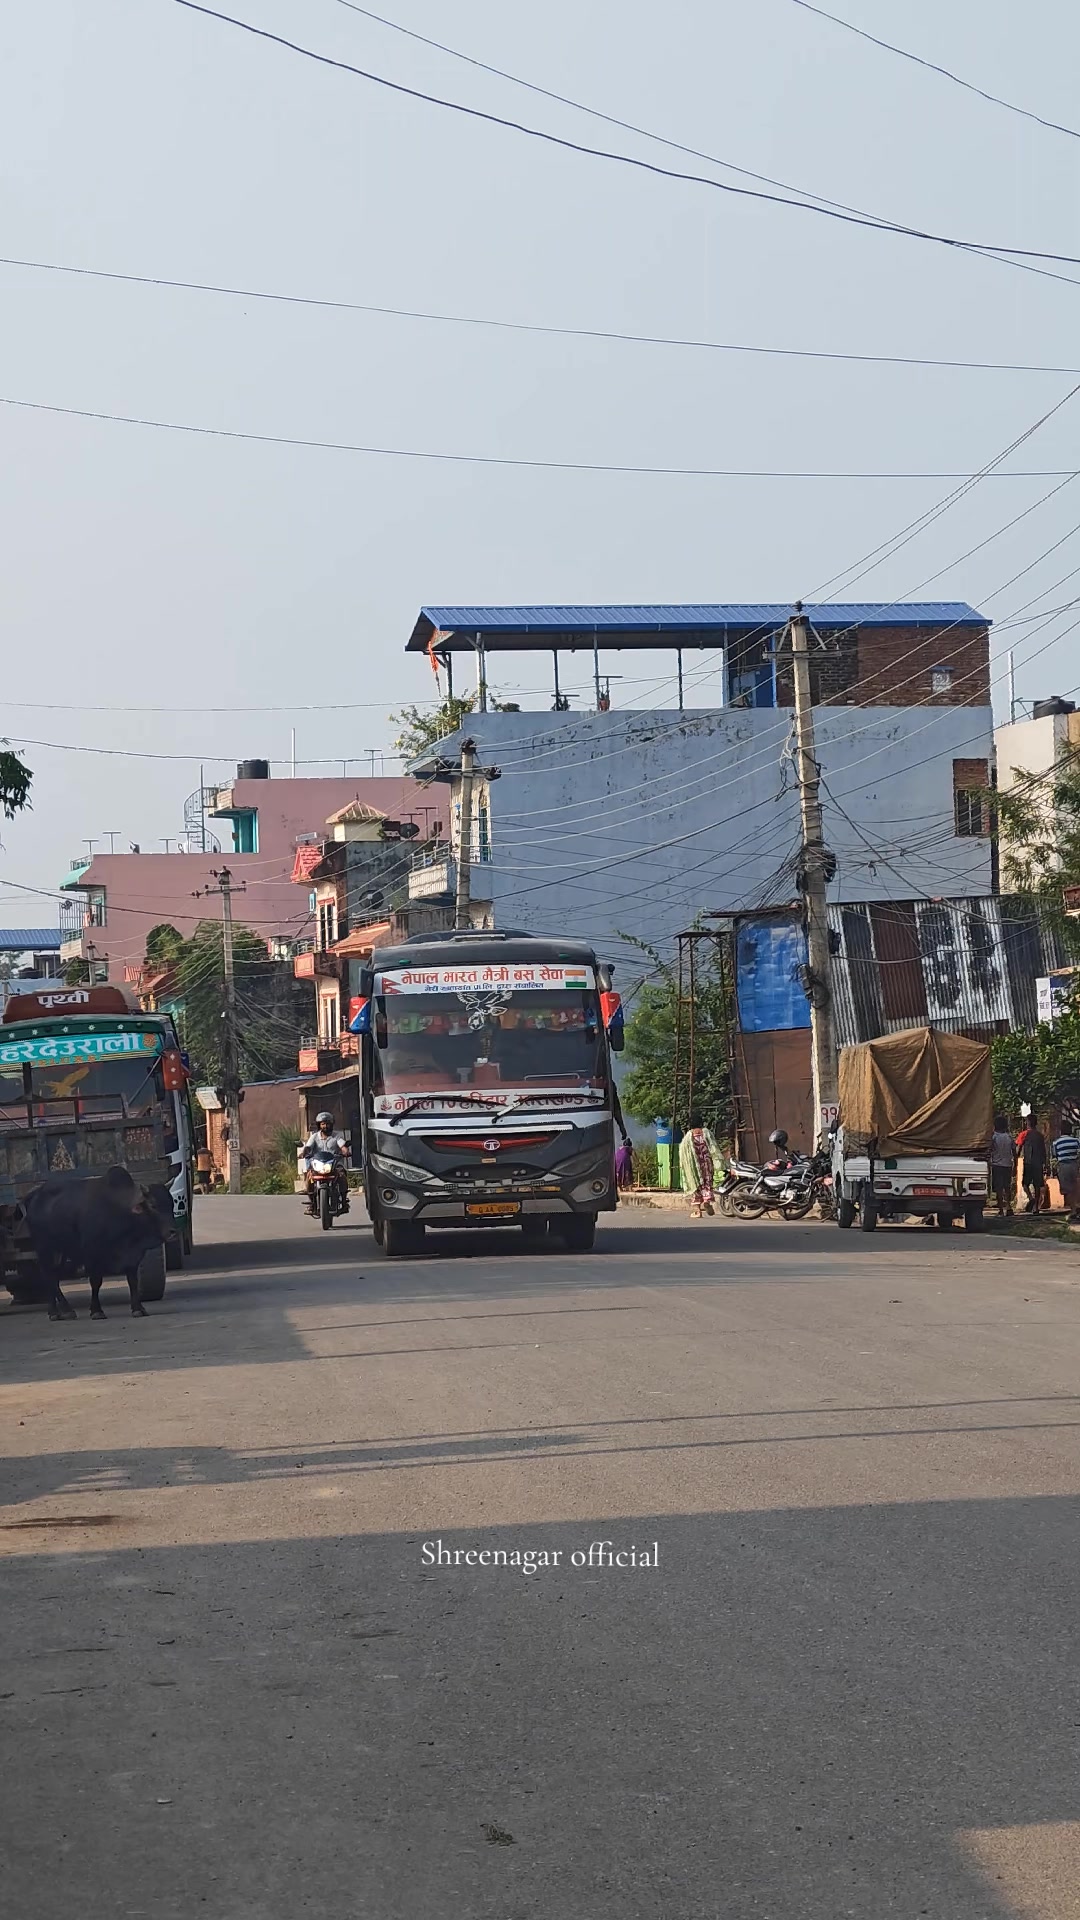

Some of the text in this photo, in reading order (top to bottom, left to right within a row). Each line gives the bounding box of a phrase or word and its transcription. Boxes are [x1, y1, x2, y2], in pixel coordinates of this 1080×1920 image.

[401, 965, 565, 985] नेपाल भारत मैत्री बस सेवा
[37, 990, 91, 1009] पृथ्वी
